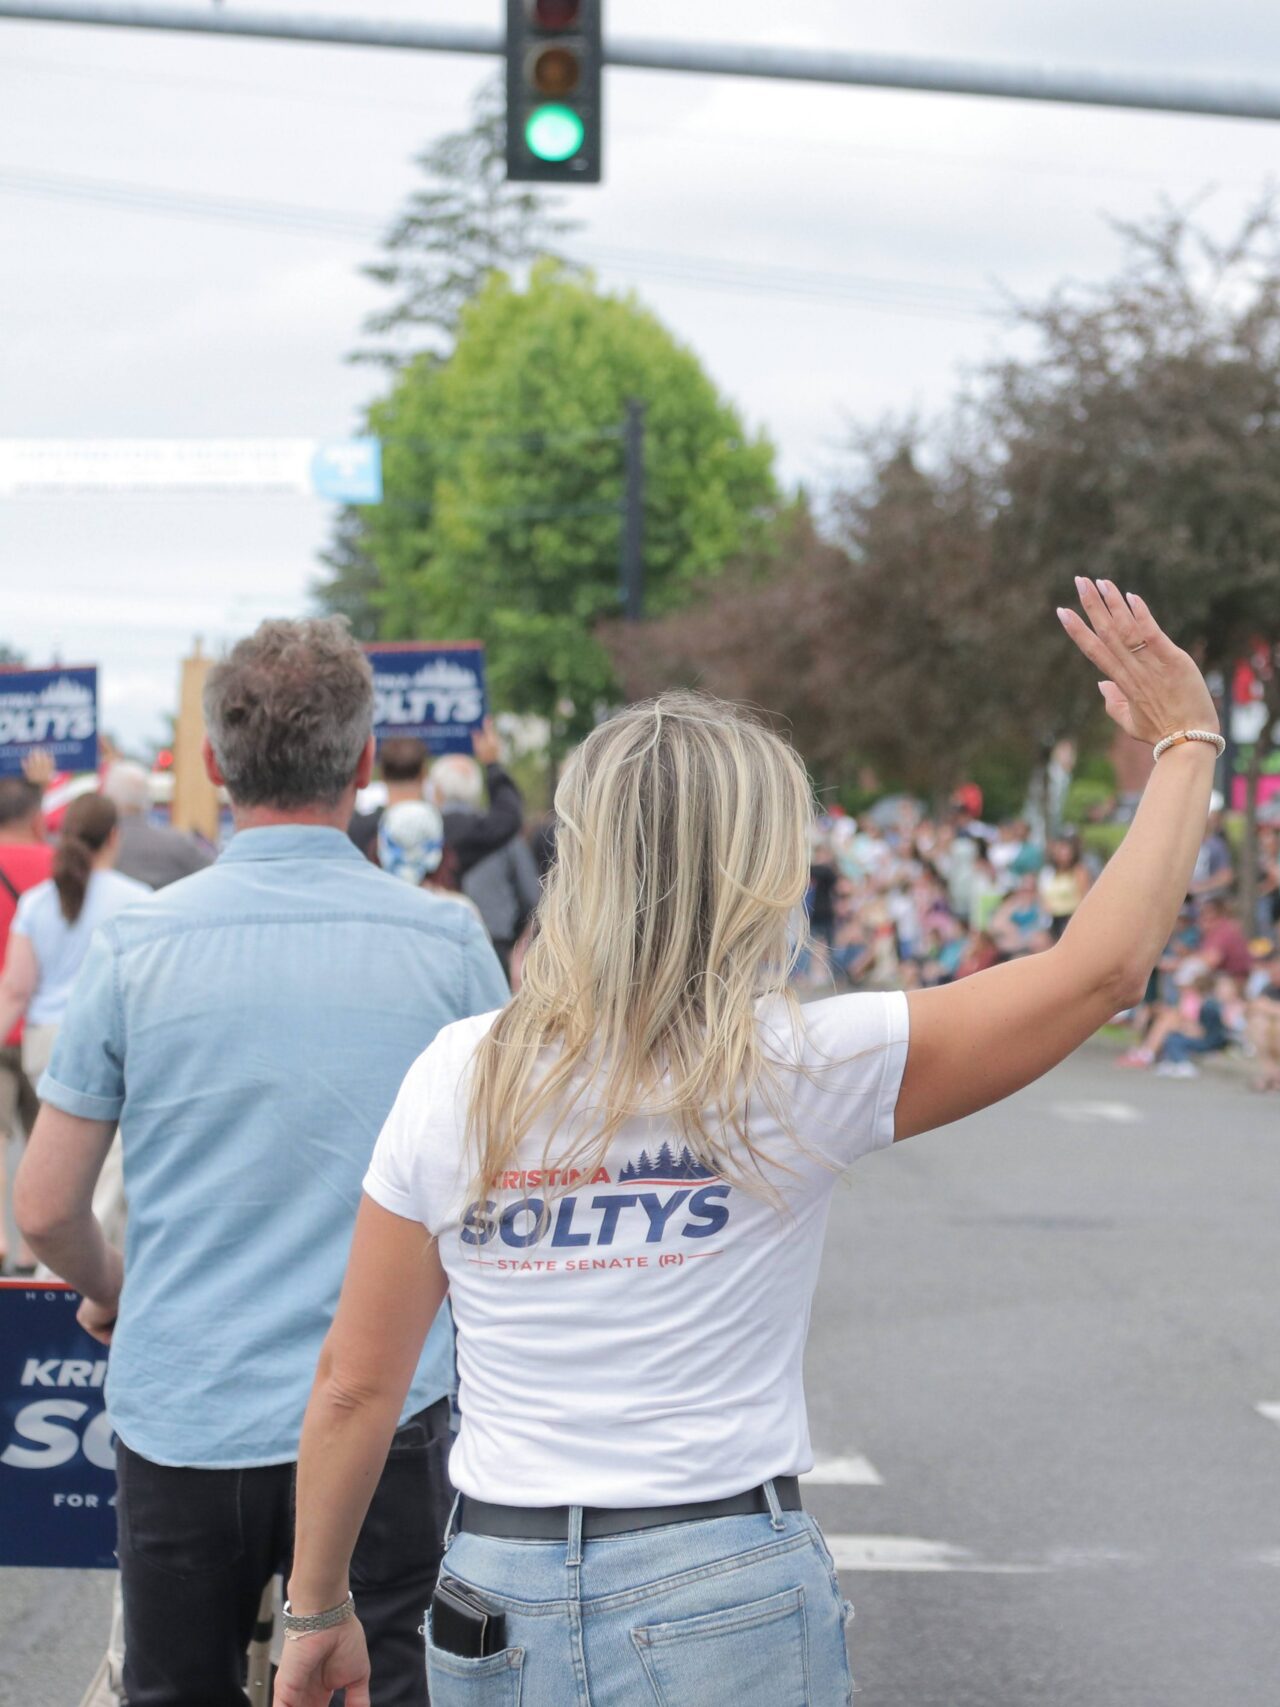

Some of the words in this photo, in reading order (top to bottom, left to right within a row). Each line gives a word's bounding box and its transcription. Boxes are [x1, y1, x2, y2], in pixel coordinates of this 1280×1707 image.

[460, 1185, 732, 1248] SOLTYS
[498, 1259, 556, 1271] STATE
[566, 1256, 648, 1270] SENATE
[658, 1254, 684, 1268] (R)
[53, 1493, 99, 1507] FOR
